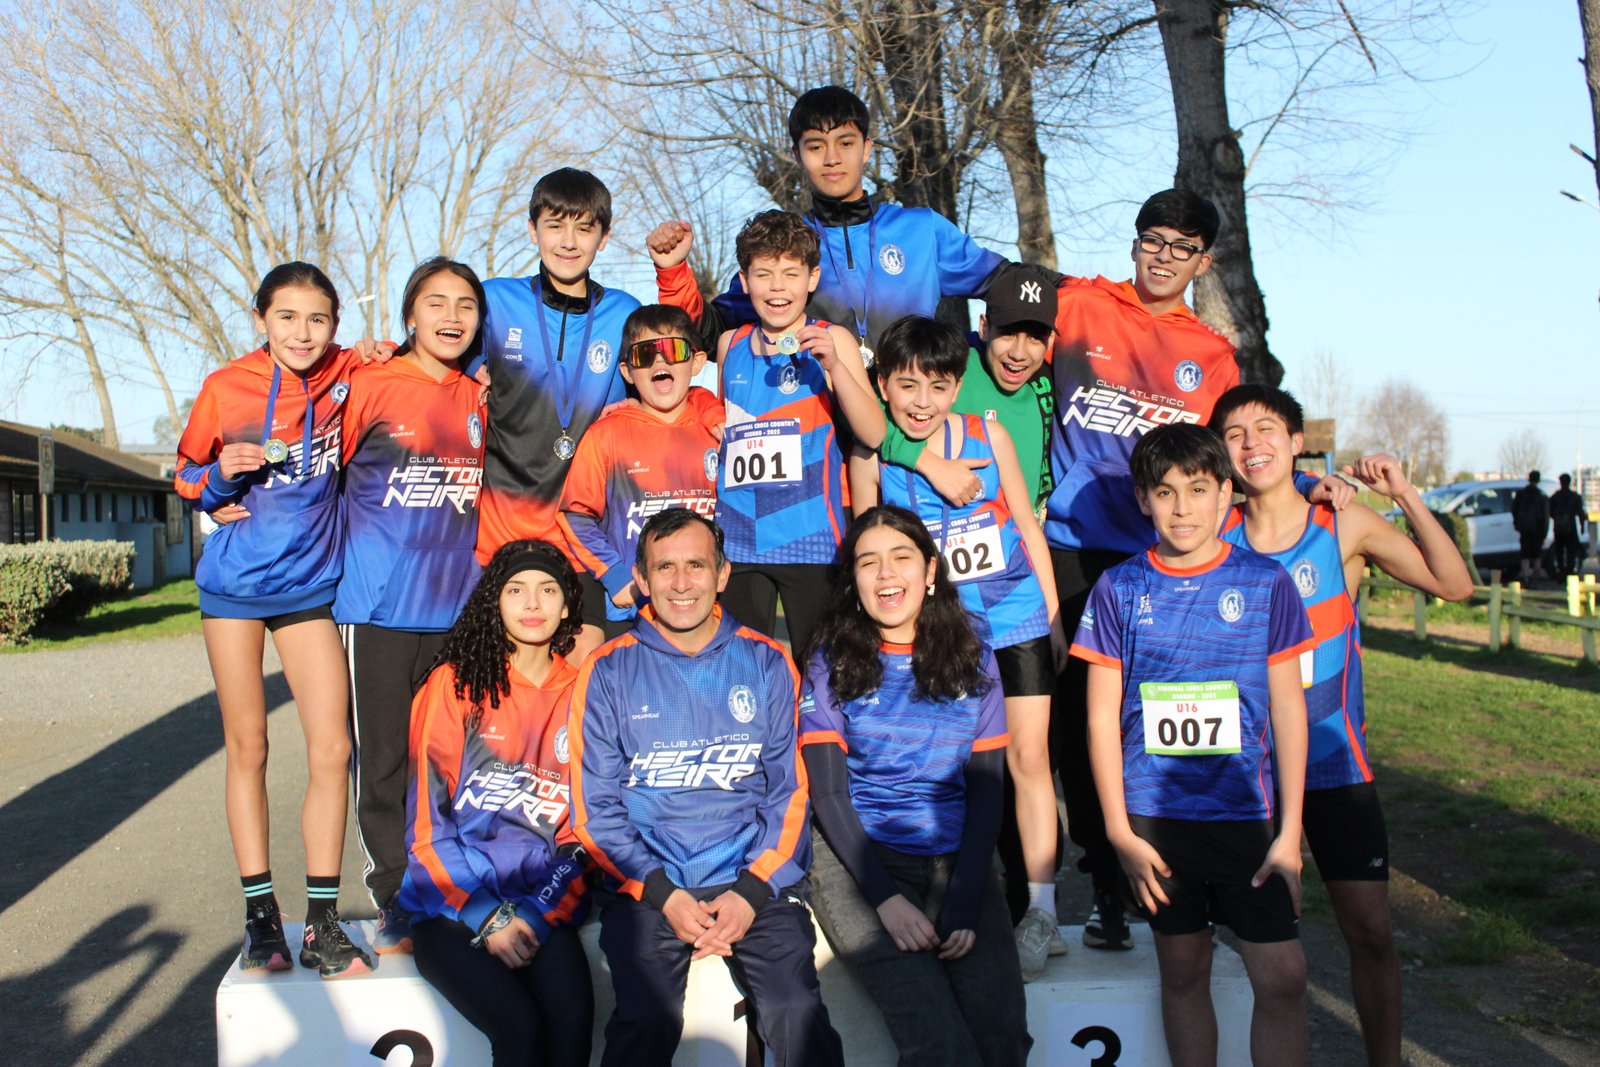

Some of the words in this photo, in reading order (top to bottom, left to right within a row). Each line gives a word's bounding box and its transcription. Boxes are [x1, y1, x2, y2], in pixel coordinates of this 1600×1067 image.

[1020, 281, 1042, 303] NY
[1069, 386, 1202, 425] HECTOR
[1096, 379, 1127, 392] CLUB
[1129, 389, 1185, 407] ATLETICO
[1031, 376, 1054, 495] CETICS
[1062, 403, 1160, 438] NEIR
[747, 439, 763, 449] U14
[409, 456, 435, 464] CLUB
[436, 456, 478, 465] ATLETICO
[733, 452, 787, 483] 001
[387, 466, 484, 488] HECTOR
[382, 484, 480, 514] NEIRA
[946, 542, 993, 575] 02
[1176, 703, 1198, 713] U16
[653, 741, 688, 749] CLUB
[690, 733, 750, 748] ATLETICO
[1158, 717, 1222, 747] 007
[629, 743, 763, 770] HECTOR
[464, 769, 570, 804] HECTOR
[454, 787, 568, 827] NEIRA
